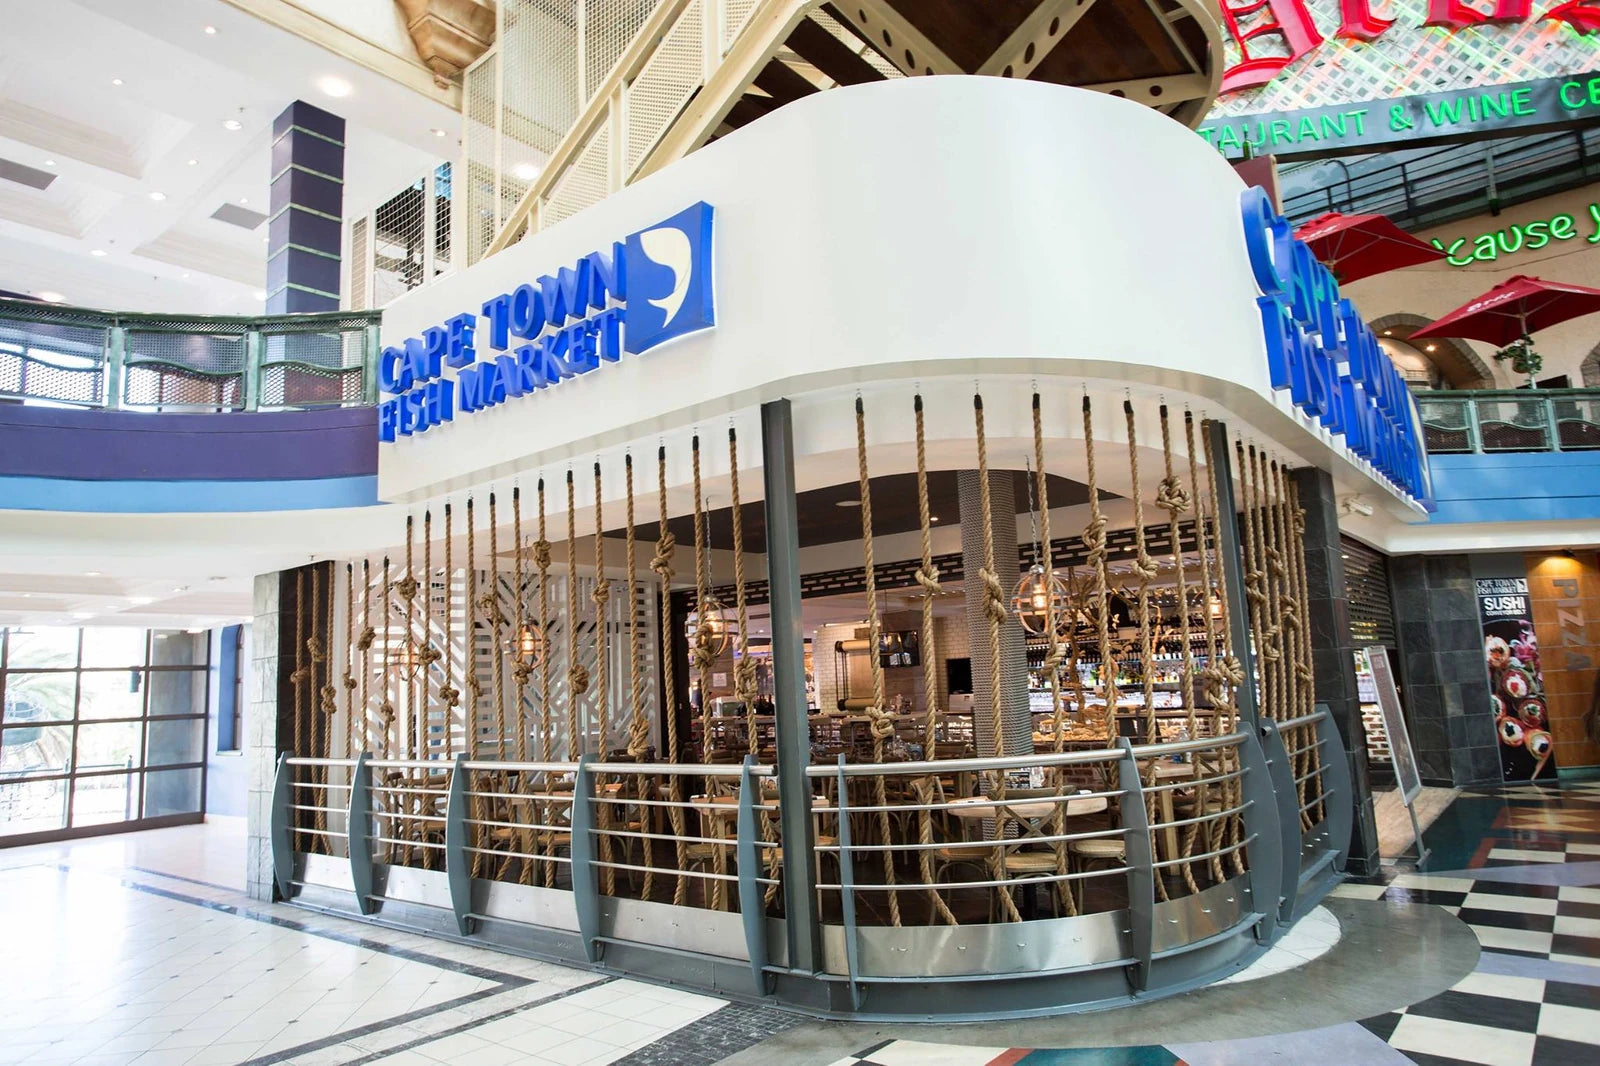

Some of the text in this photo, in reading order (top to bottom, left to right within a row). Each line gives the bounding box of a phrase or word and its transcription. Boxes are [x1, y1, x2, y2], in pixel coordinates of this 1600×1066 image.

[1389, 104, 1414, 132] &
[1425, 87, 1536, 127] WINE
[378, 241, 627, 394] CAPE TOWN
[378, 307, 627, 443] FISH MARKET
[1484, 596, 1526, 610] SUSHI
[1552, 579, 1592, 671] PIZZA
